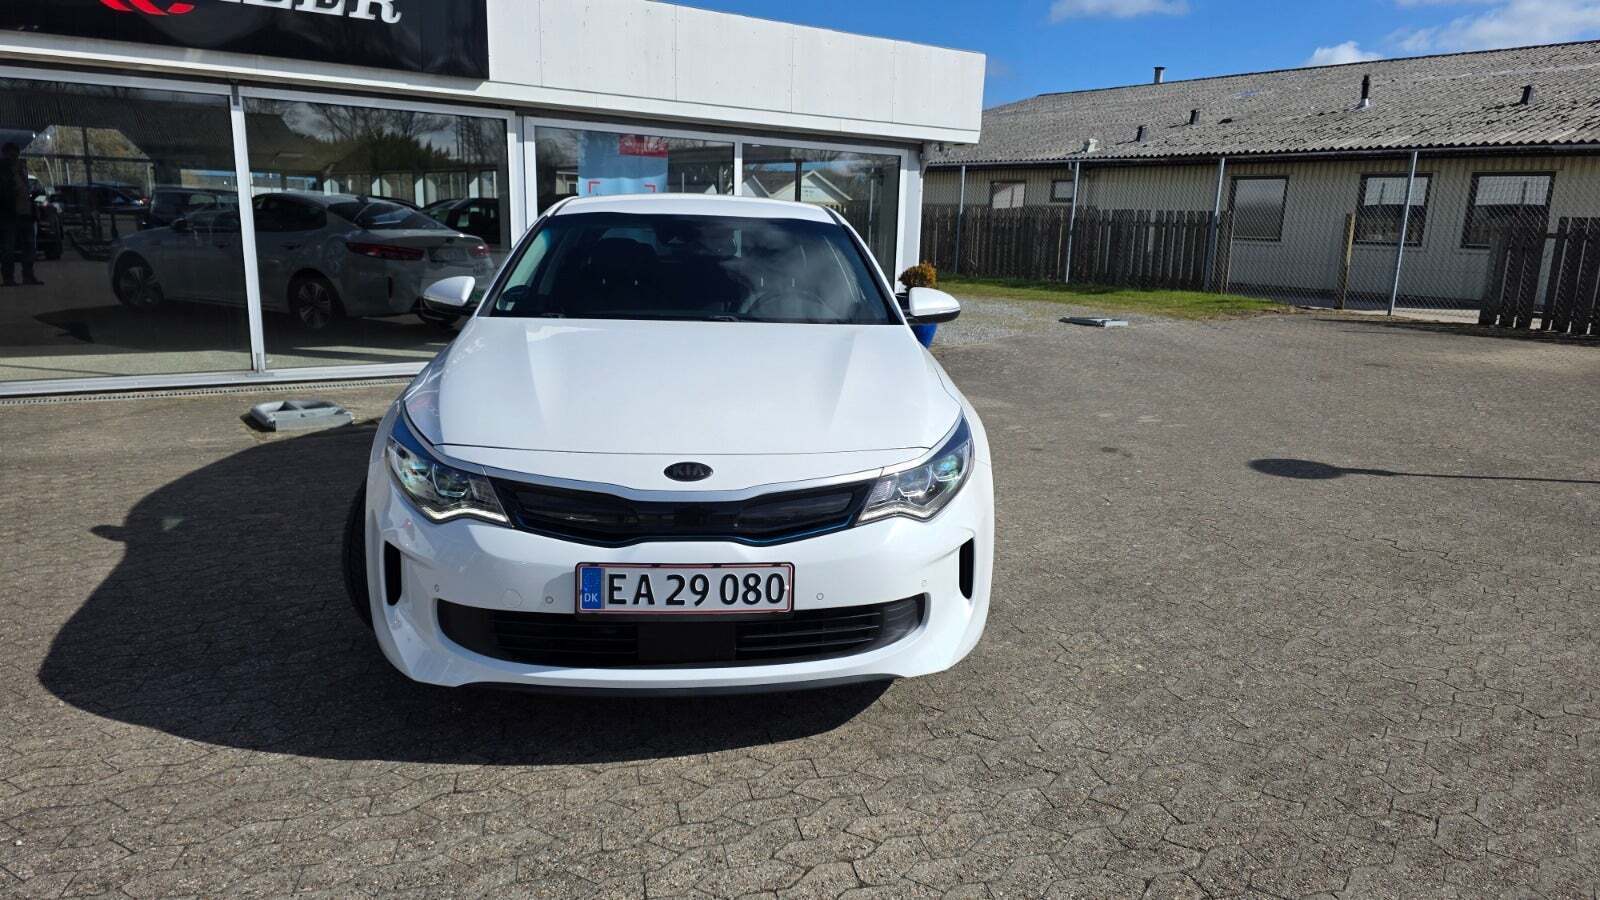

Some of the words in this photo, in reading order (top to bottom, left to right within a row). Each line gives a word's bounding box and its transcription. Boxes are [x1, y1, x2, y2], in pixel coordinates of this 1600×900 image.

[671, 463, 706, 476] KIA
[608, 573, 655, 605] EA
[666, 574, 710, 606] 29
[720, 573, 785, 605] 080
[584, 593, 599, 603] DK
